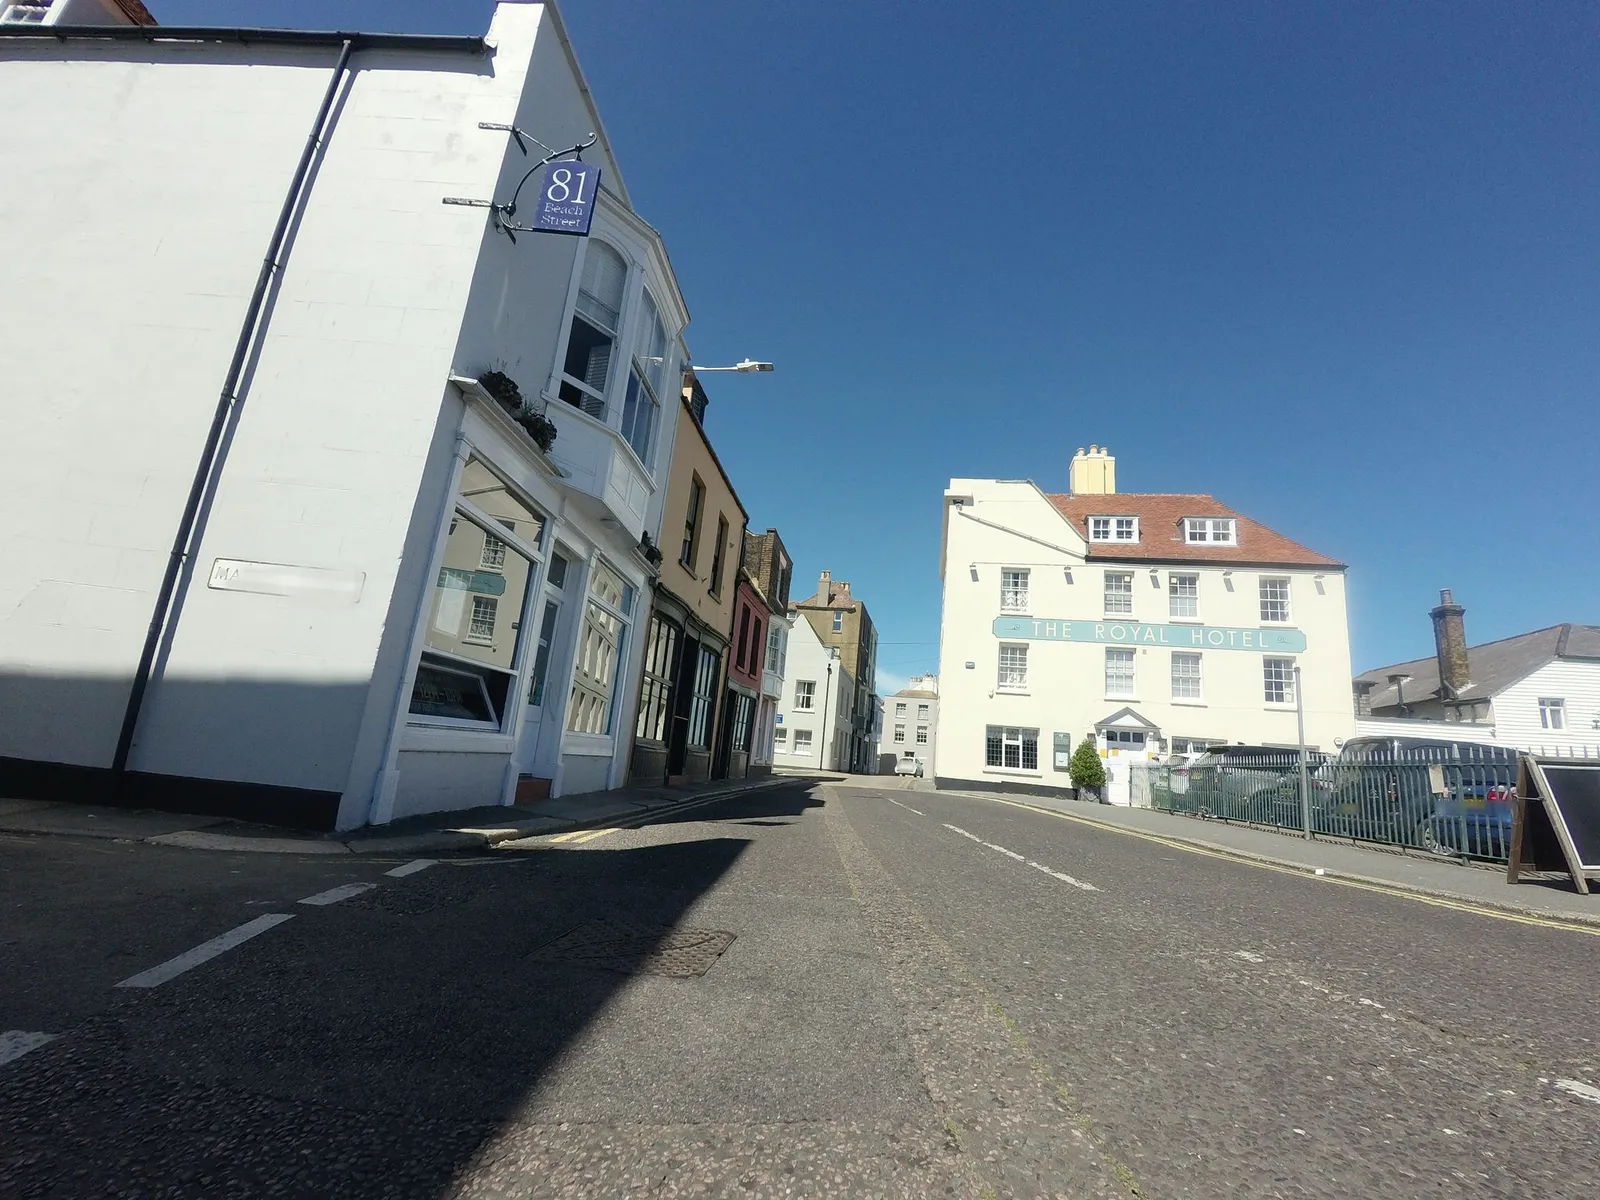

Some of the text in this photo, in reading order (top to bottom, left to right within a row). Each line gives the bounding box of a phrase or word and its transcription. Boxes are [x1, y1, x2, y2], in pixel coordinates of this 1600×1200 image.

[547, 168, 586, 204] 81
[544, 202, 583, 216] Beach
[541, 213, 581, 227] Street
[1032, 621, 1269, 648] THE ROYAL HOTEL
